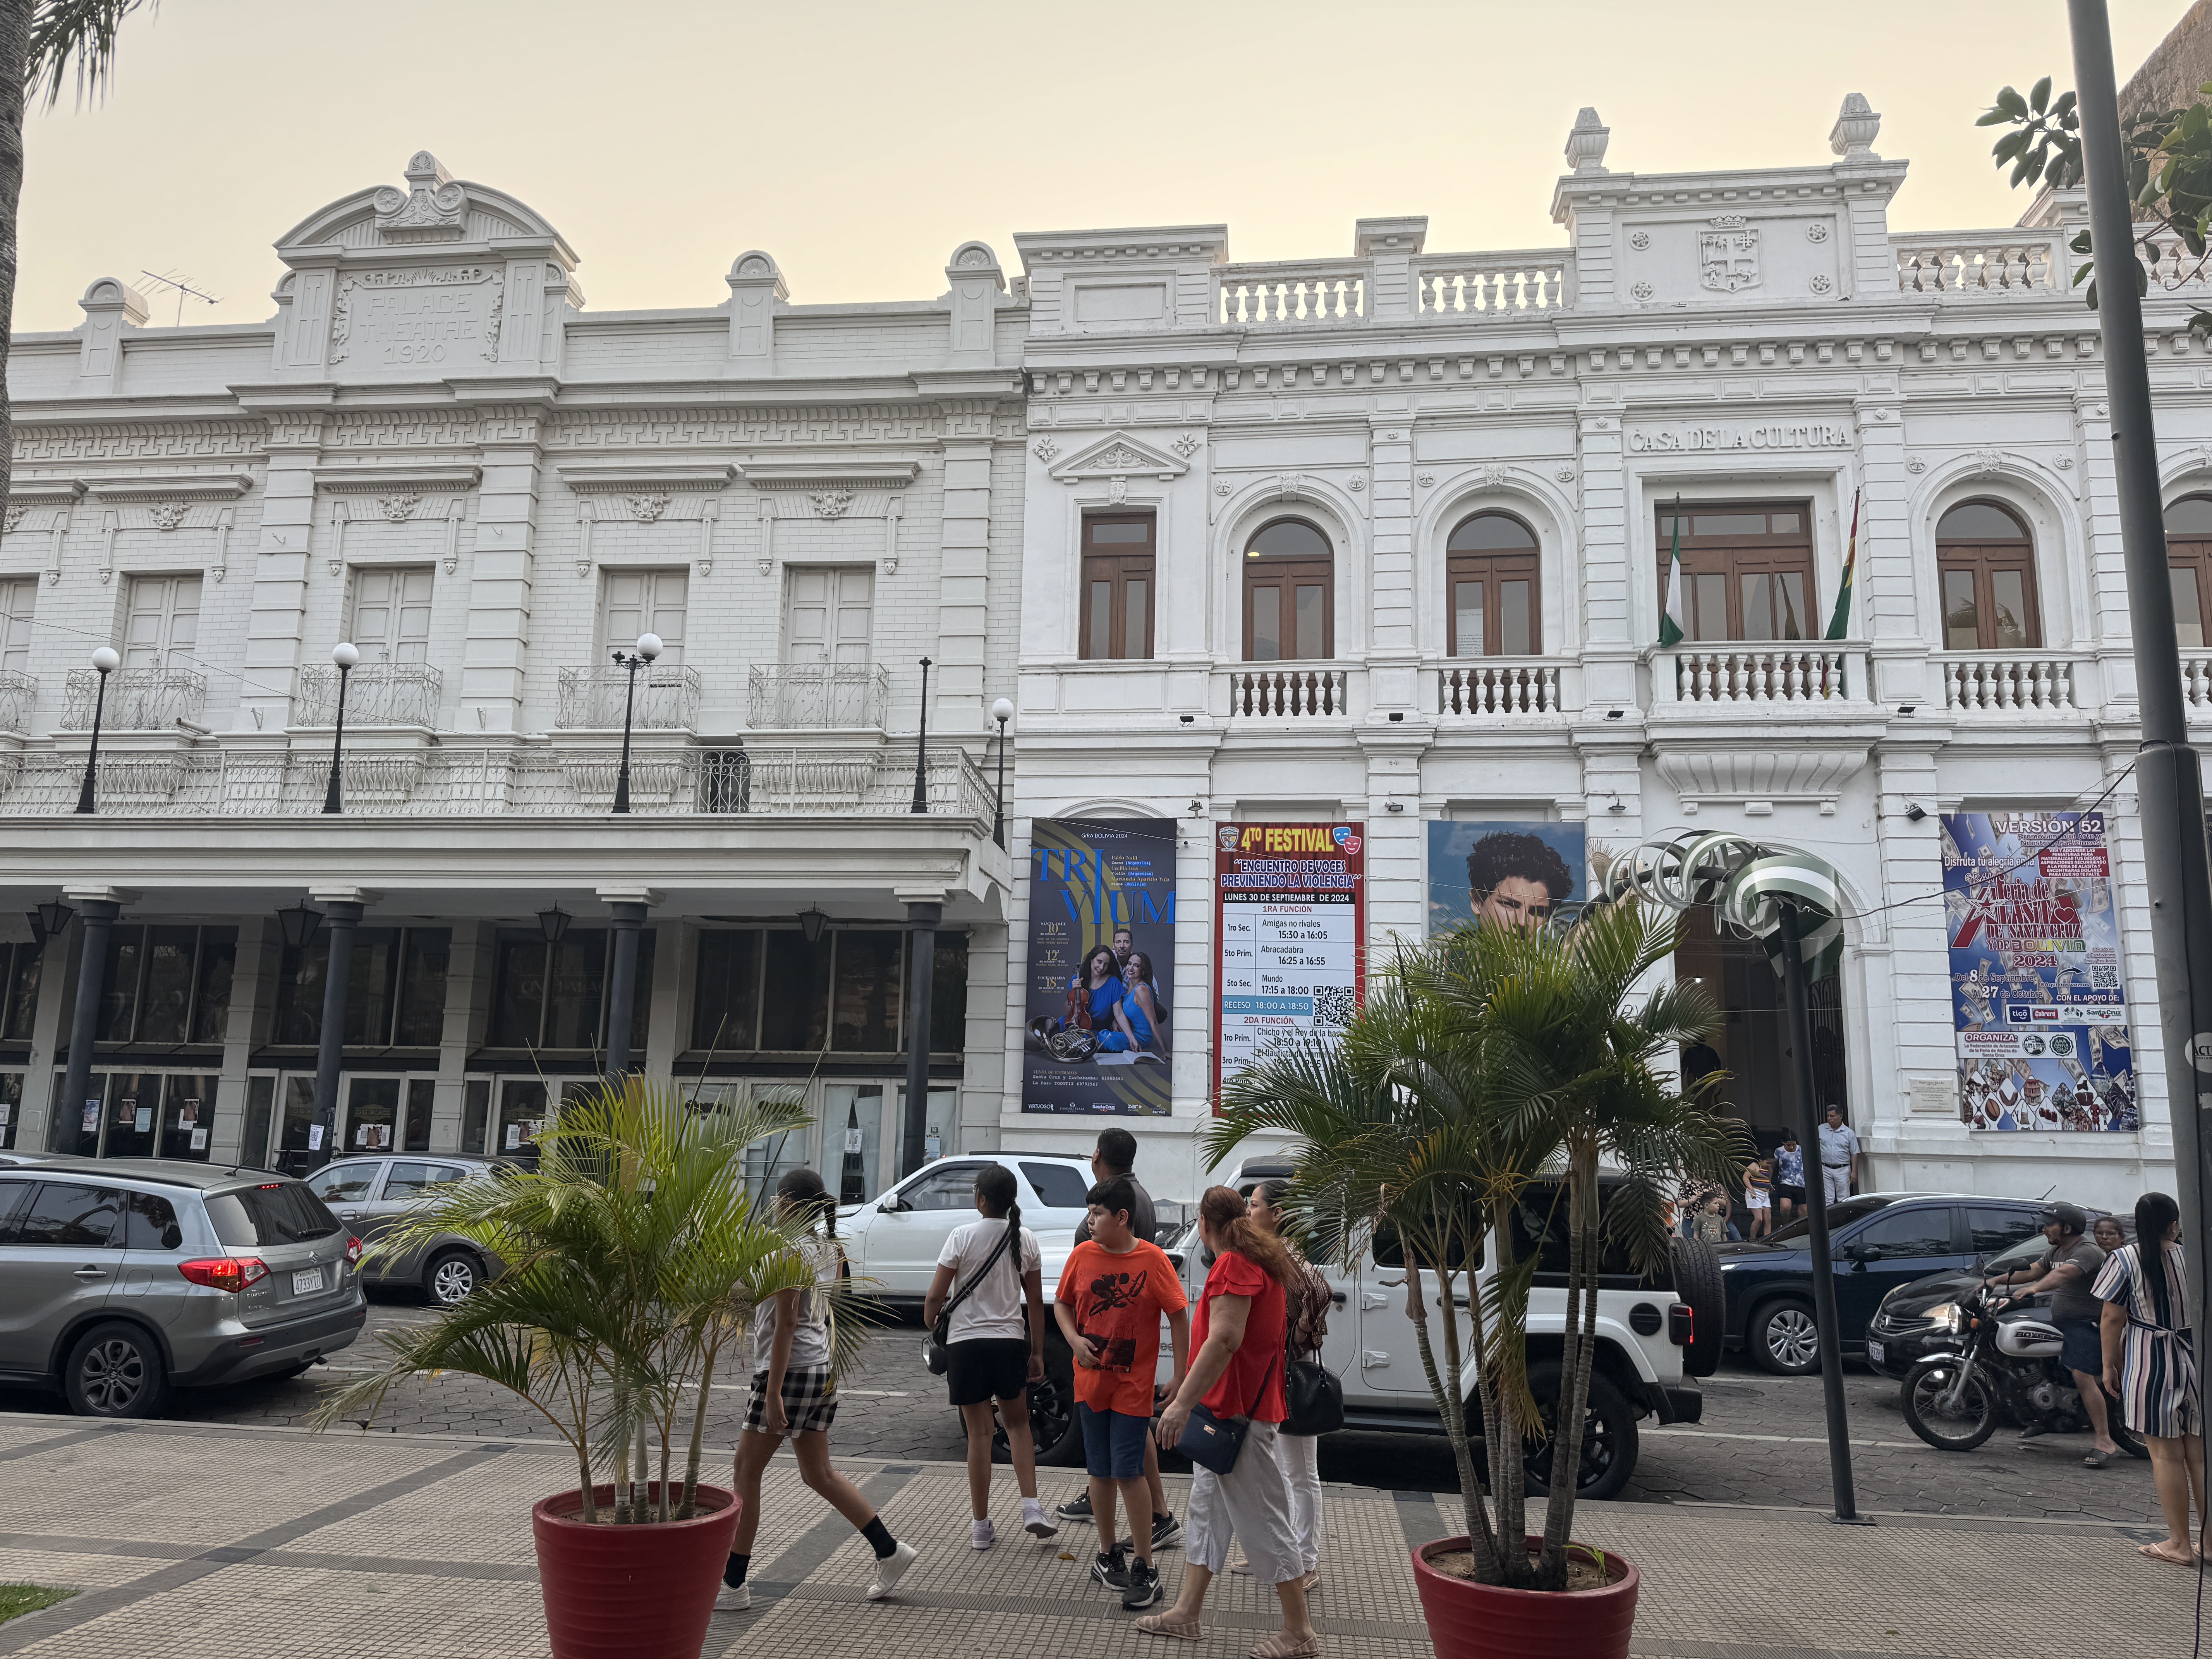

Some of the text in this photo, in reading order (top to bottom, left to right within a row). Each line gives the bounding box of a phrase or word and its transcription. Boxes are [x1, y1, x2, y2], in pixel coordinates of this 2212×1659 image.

[368, 292, 472, 316] PALACE
[360, 318, 479, 342] THEATRE
[384, 344, 446, 364] 1920
[1629, 424, 1852, 451] CASA DE LA CULTURA
[1996, 817, 2102, 833] VERSIÓN 52
[1242, 827, 1335, 852] 4TO FESTIVAL
[1300, 859, 1314, 873] DE
[1315, 860, 1346, 873] VOCES
[1944, 856, 1975, 867] Disfruta
[1978, 856, 1986, 867] tú
[1221, 874, 1287, 888] PREVINIENDO
[1288, 874, 1300, 888] LA
[2033, 878, 2049, 900] de
[1280, 904, 1312, 913] FUNCIÓN
[1048, 924, 1059, 934] 10
[1262, 919, 1287, 929] Amigas
[1279, 931, 1298, 939] 15:30
[1307, 931, 1328, 939] 16:05
[1986, 924, 2082, 938] DE SANTA CRUZ
[1986, 939, 1994, 951] Y
[1994, 939, 2011, 951] DE
[2011, 939, 2087, 951] BOLIVIA
[1048, 951, 1058, 961] 12
[1278, 957, 1297, 965] 16:25
[1307, 957, 1325, 965] 16:55
[2014, 954, 2058, 967] 2024
[1956, 969, 2034, 984] Del 8 de Septiembre
[1047, 979, 1057, 988] 18
[1261, 986, 1278, 994] 17:15
[1288, 986, 1309, 994] 18:00
[1973, 986, 2044, 998] Al 27 de Octubre
[1262, 1016, 1294, 1024] FUNCIÓN
[1257, 1027, 1279, 1036] Chicho
[1295, 1029, 1307, 1037] Rey
[1965, 1033, 2018, 1041] ORGANIZA:
[1273, 1038, 1293, 1046] 18:50
